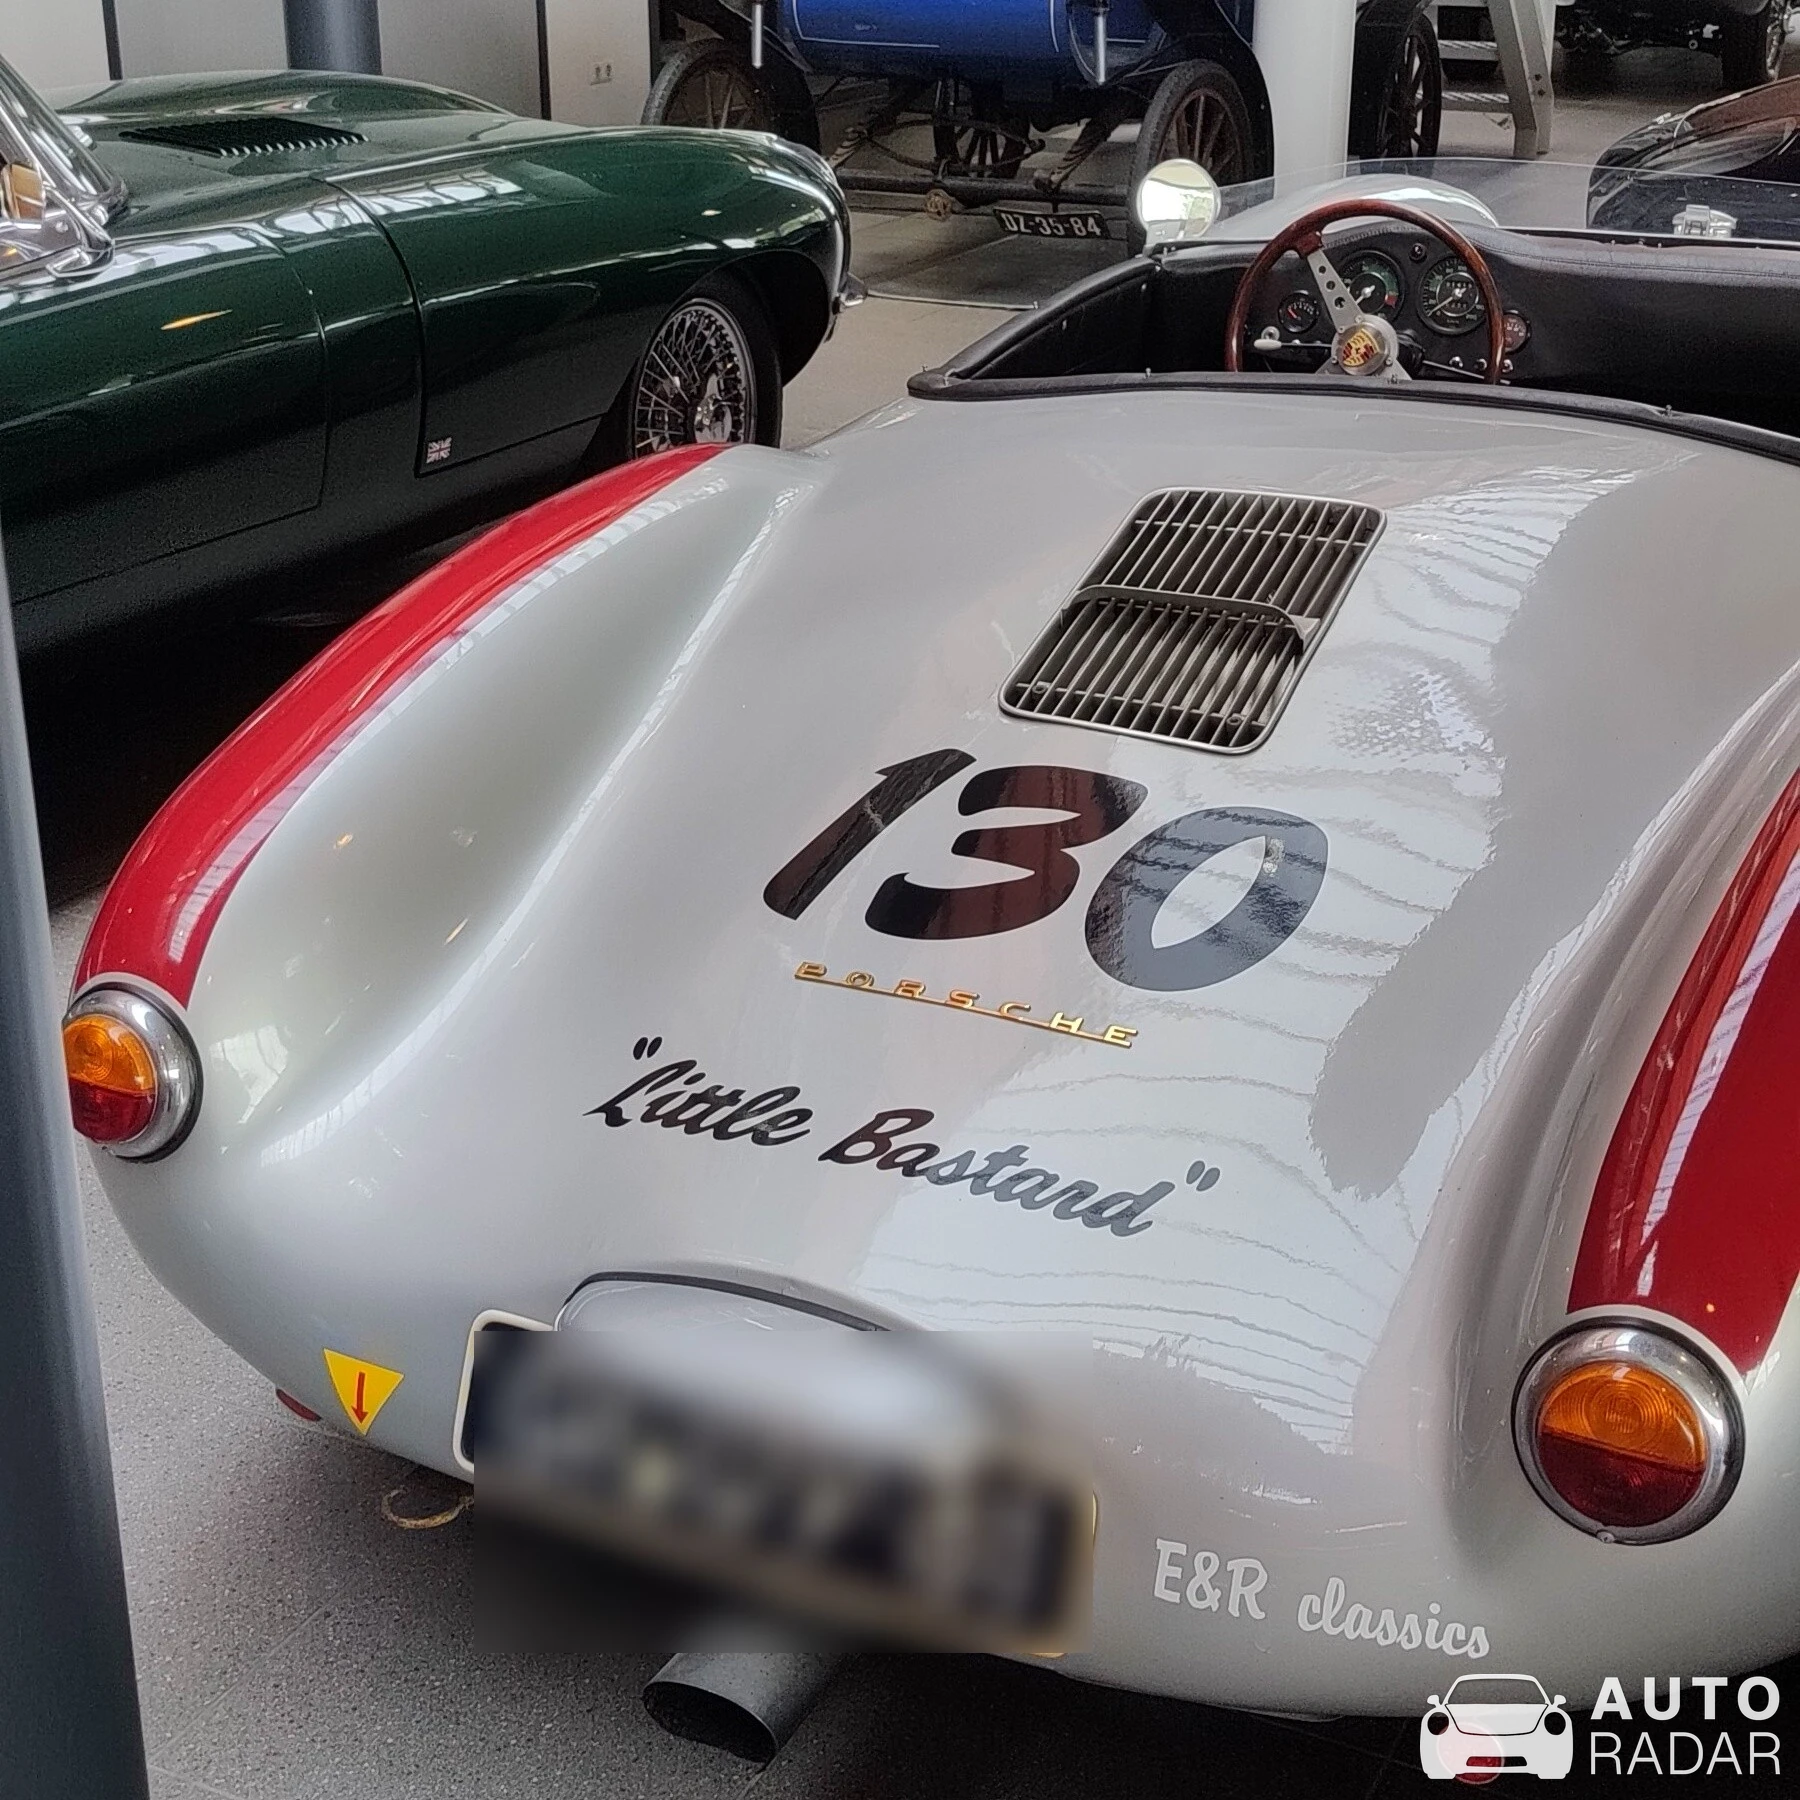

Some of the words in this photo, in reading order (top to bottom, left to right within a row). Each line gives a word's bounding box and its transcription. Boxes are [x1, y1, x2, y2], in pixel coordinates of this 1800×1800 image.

[763, 748, 1329, 992] 130
[795, 961, 1139, 1048] PORSCHE
[1153, 1537, 1268, 1620] E&R
[1297, 1577, 1490, 1659] classics
